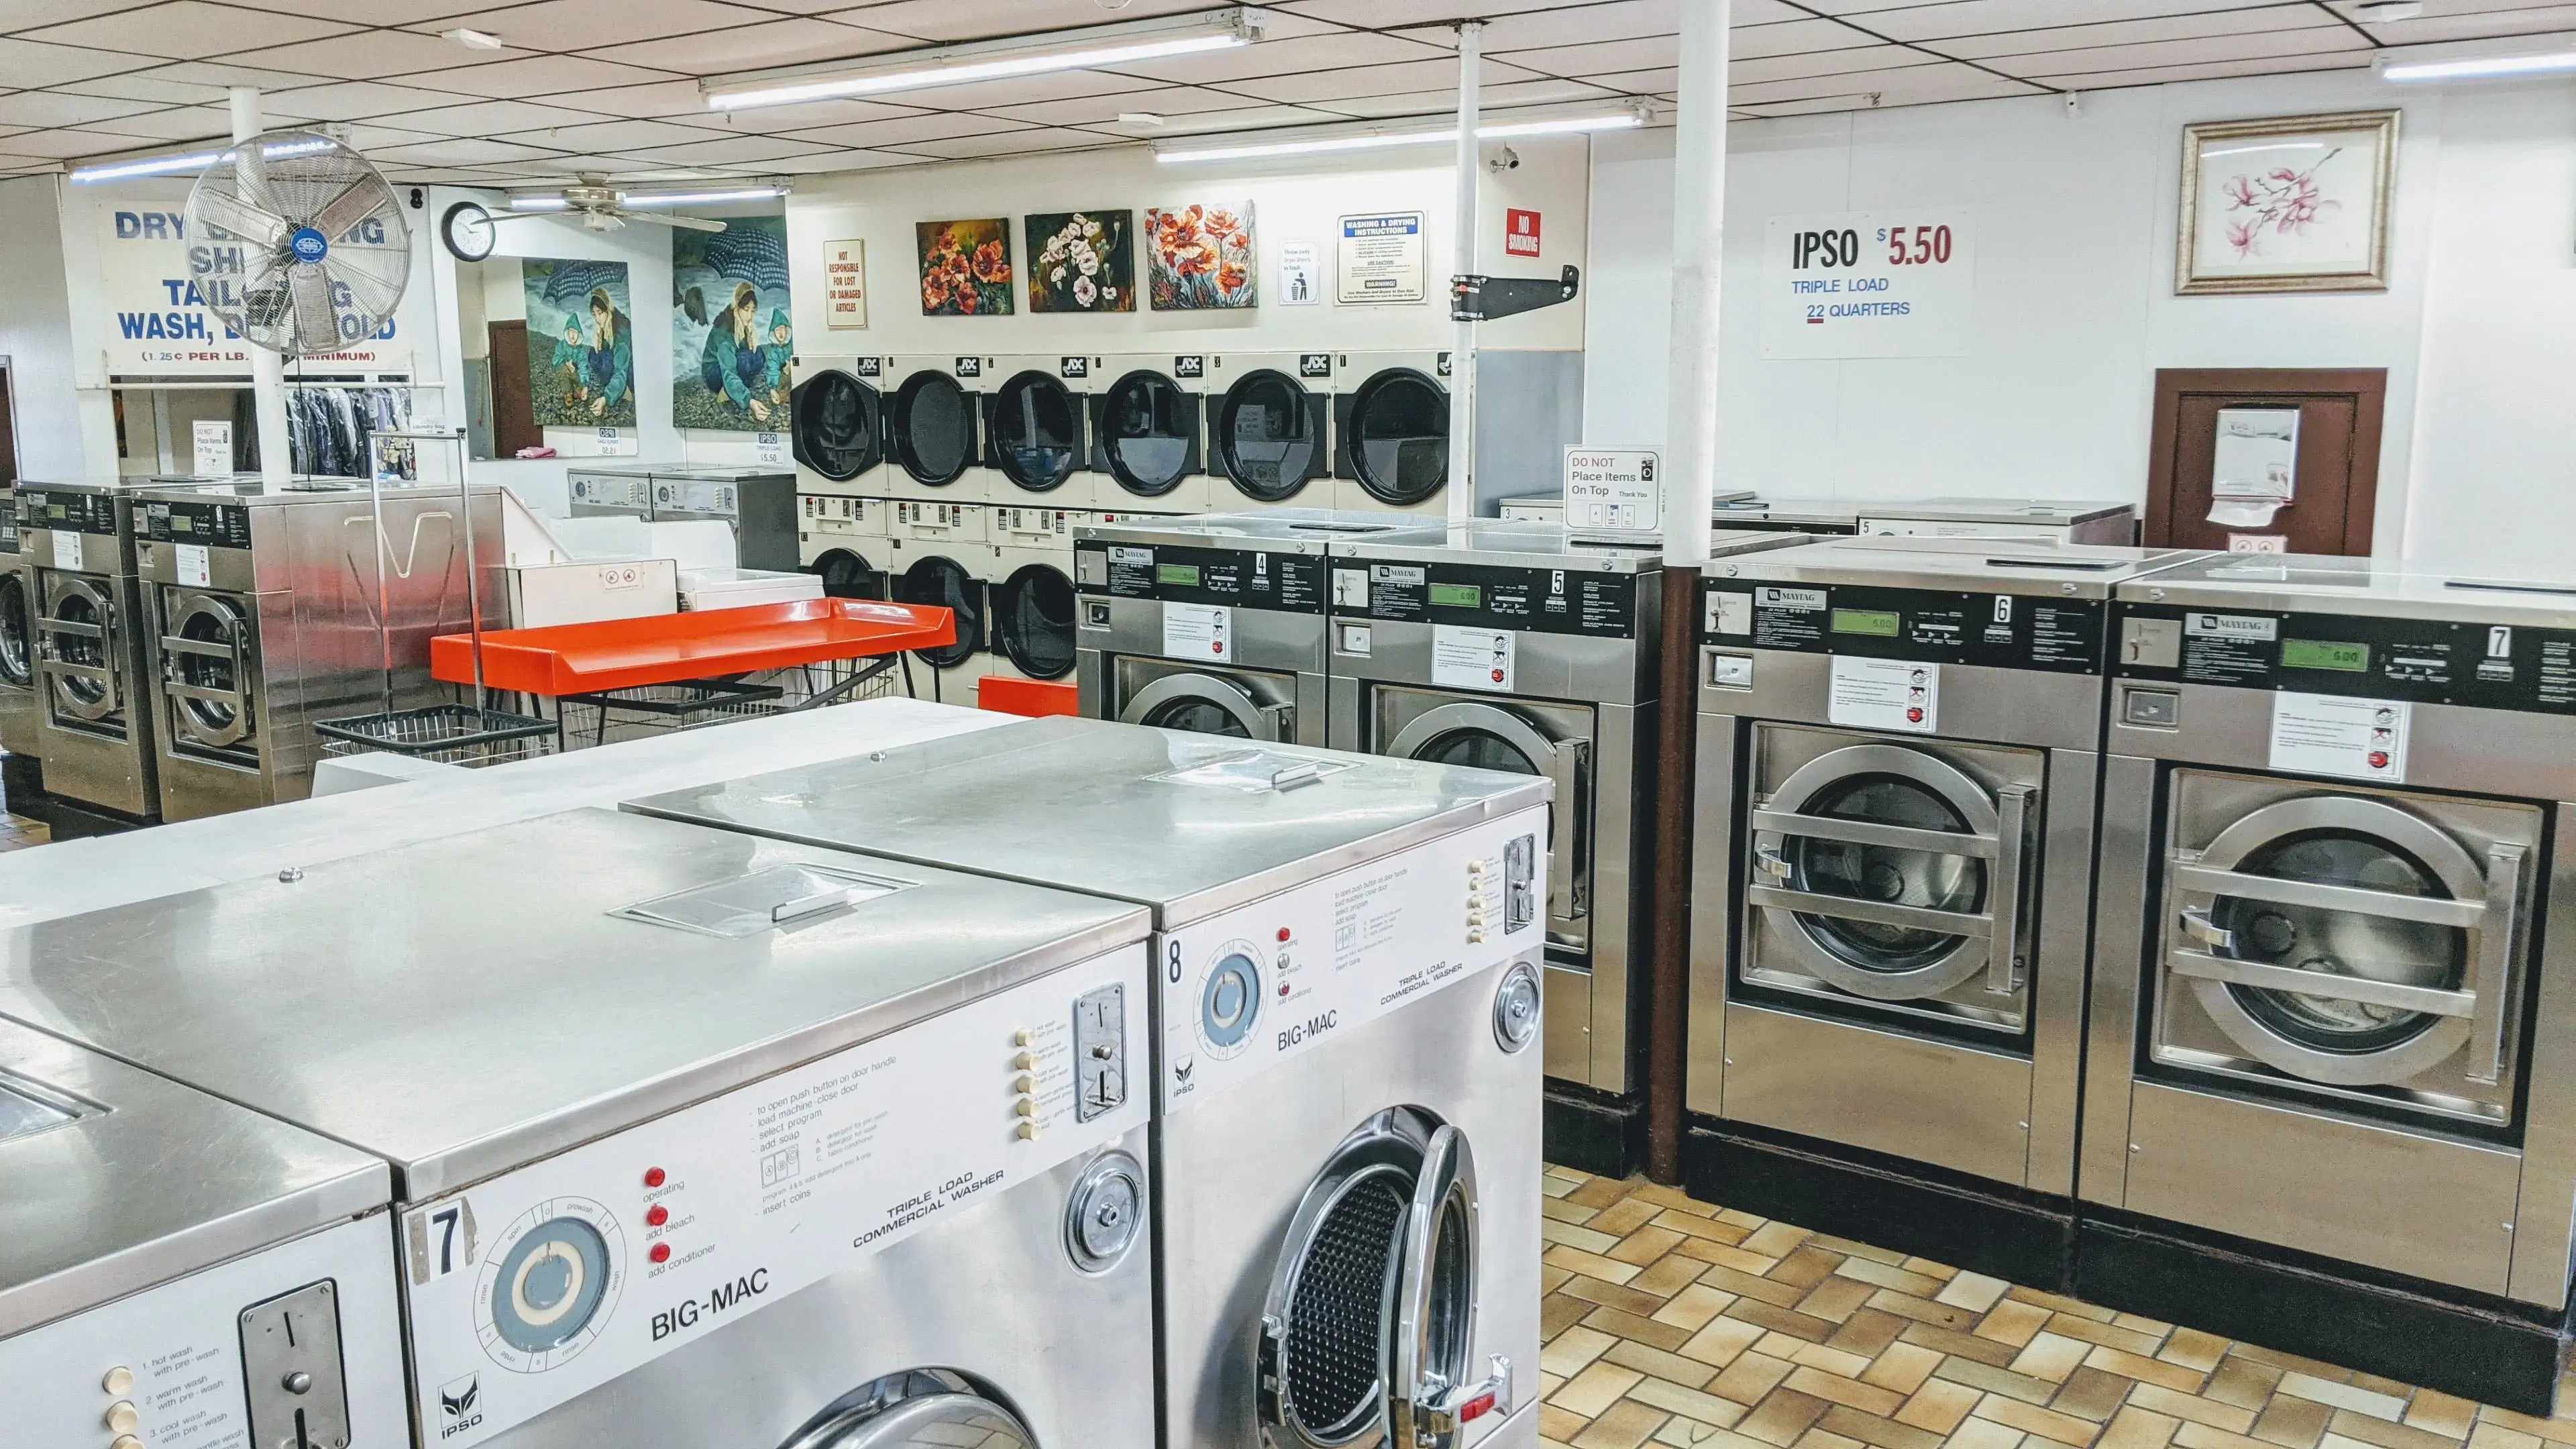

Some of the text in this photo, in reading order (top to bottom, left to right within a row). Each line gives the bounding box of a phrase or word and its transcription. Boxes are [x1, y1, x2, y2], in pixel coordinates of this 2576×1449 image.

[115, 211, 184, 239] DRY
[1346, 220, 1379, 229] WASHING
[1388, 218, 1415, 226] DRYING
[1354, 226, 1407, 236] INSTRUCTIONS
[1518, 215, 1529, 234] NO
[1508, 233, 1538, 252] SMOKING
[1792, 225, 1952, 269] IPSO $5.50
[839, 251, 848, 261] NOT
[829, 262, 859, 274] RESPONSIBLE
[834, 276, 856, 286] FOR LOST
[1366, 280, 1396, 288] WARNING!
[1792, 278, 1889, 294] TRIPLE LOAD
[829, 289, 861, 299] OR DAMAGED
[836, 303, 857, 313] ARTICLES
[1807, 302, 1911, 318] 22 QUARTERS
[118, 313, 214, 345] WASH,
[189, 352, 220, 361] PER
[225, 352, 250, 361] LB.
[759, 434, 777, 443] IPSO
[761, 453, 777, 462] $5.50
[1572, 458, 1615, 467] DO NOT
[1572, 471, 1636, 482] Place Items
[1572, 485, 1587, 494] On
[1589, 486, 1609, 497] Top
[1505, 508, 1510, 519] 3
[1863, 521, 1870, 533] 5
[1125, 550, 1146, 558] MAYTAG
[1390, 569, 1416, 578] MAYTAG
[1781, 592, 1815, 602] MAYTAG
[2220, 620, 2261, 631] MAYTAG
[1277, 939, 1299, 951] operating
[1169, 939, 1182, 983] 8
[1277, 969, 1286, 979] add
[1399, 961, 1446, 987] TRIPLE LOAD
[1380, 963, 1462, 1005] COMMERCIAL WASHER
[1277, 996, 1287, 1006] add
[1278, 1009, 1338, 1052] BIG-MAC
[757, 1055, 897, 1115] to open push button on door handle
[1174, 1083, 1195, 1098] IPSO
[757, 1112, 775, 1128] load
[778, 1100, 813, 1120] machine
[841, 1082, 859, 1096] door
[759, 1109, 822, 1140] select program
[760, 1130, 800, 1152] add soap
[643, 1181, 685, 1203] operating
[887, 1171, 973, 1218] TRIPLE LOAD
[567, 1202, 593, 1214] prewash
[763, 1188, 811, 1216] insert coins
[853, 1170, 1004, 1248] COMMERCIAL WASHER
[507, 1225, 522, 1241] spin
[645, 1214, 695, 1242] add bleach
[433, 1208, 458, 1275] 7
[648, 1243, 716, 1279] add conditioner
[612, 1270, 620, 1292] wash
[480, 1283, 488, 1305] rinse
[651, 1267, 769, 1342] BIG-MAC
[152, 1355, 167, 1367] hot
[169, 1346, 193, 1360] wash
[500, 1350, 516, 1363] rinse
[562, 1342, 580, 1357] rinse
[154, 1364, 172, 1378] with
[156, 1385, 182, 1401] warm
[184, 1375, 208, 1390] wash
[158, 1395, 177, 1411] with
[160, 1419, 179, 1434] cool
[182, 1410, 207, 1426] wash
[441, 1414, 483, 1440] IPSO
[162, 1432, 180, 1444] with
[222, 1428, 244, 1442] wash
